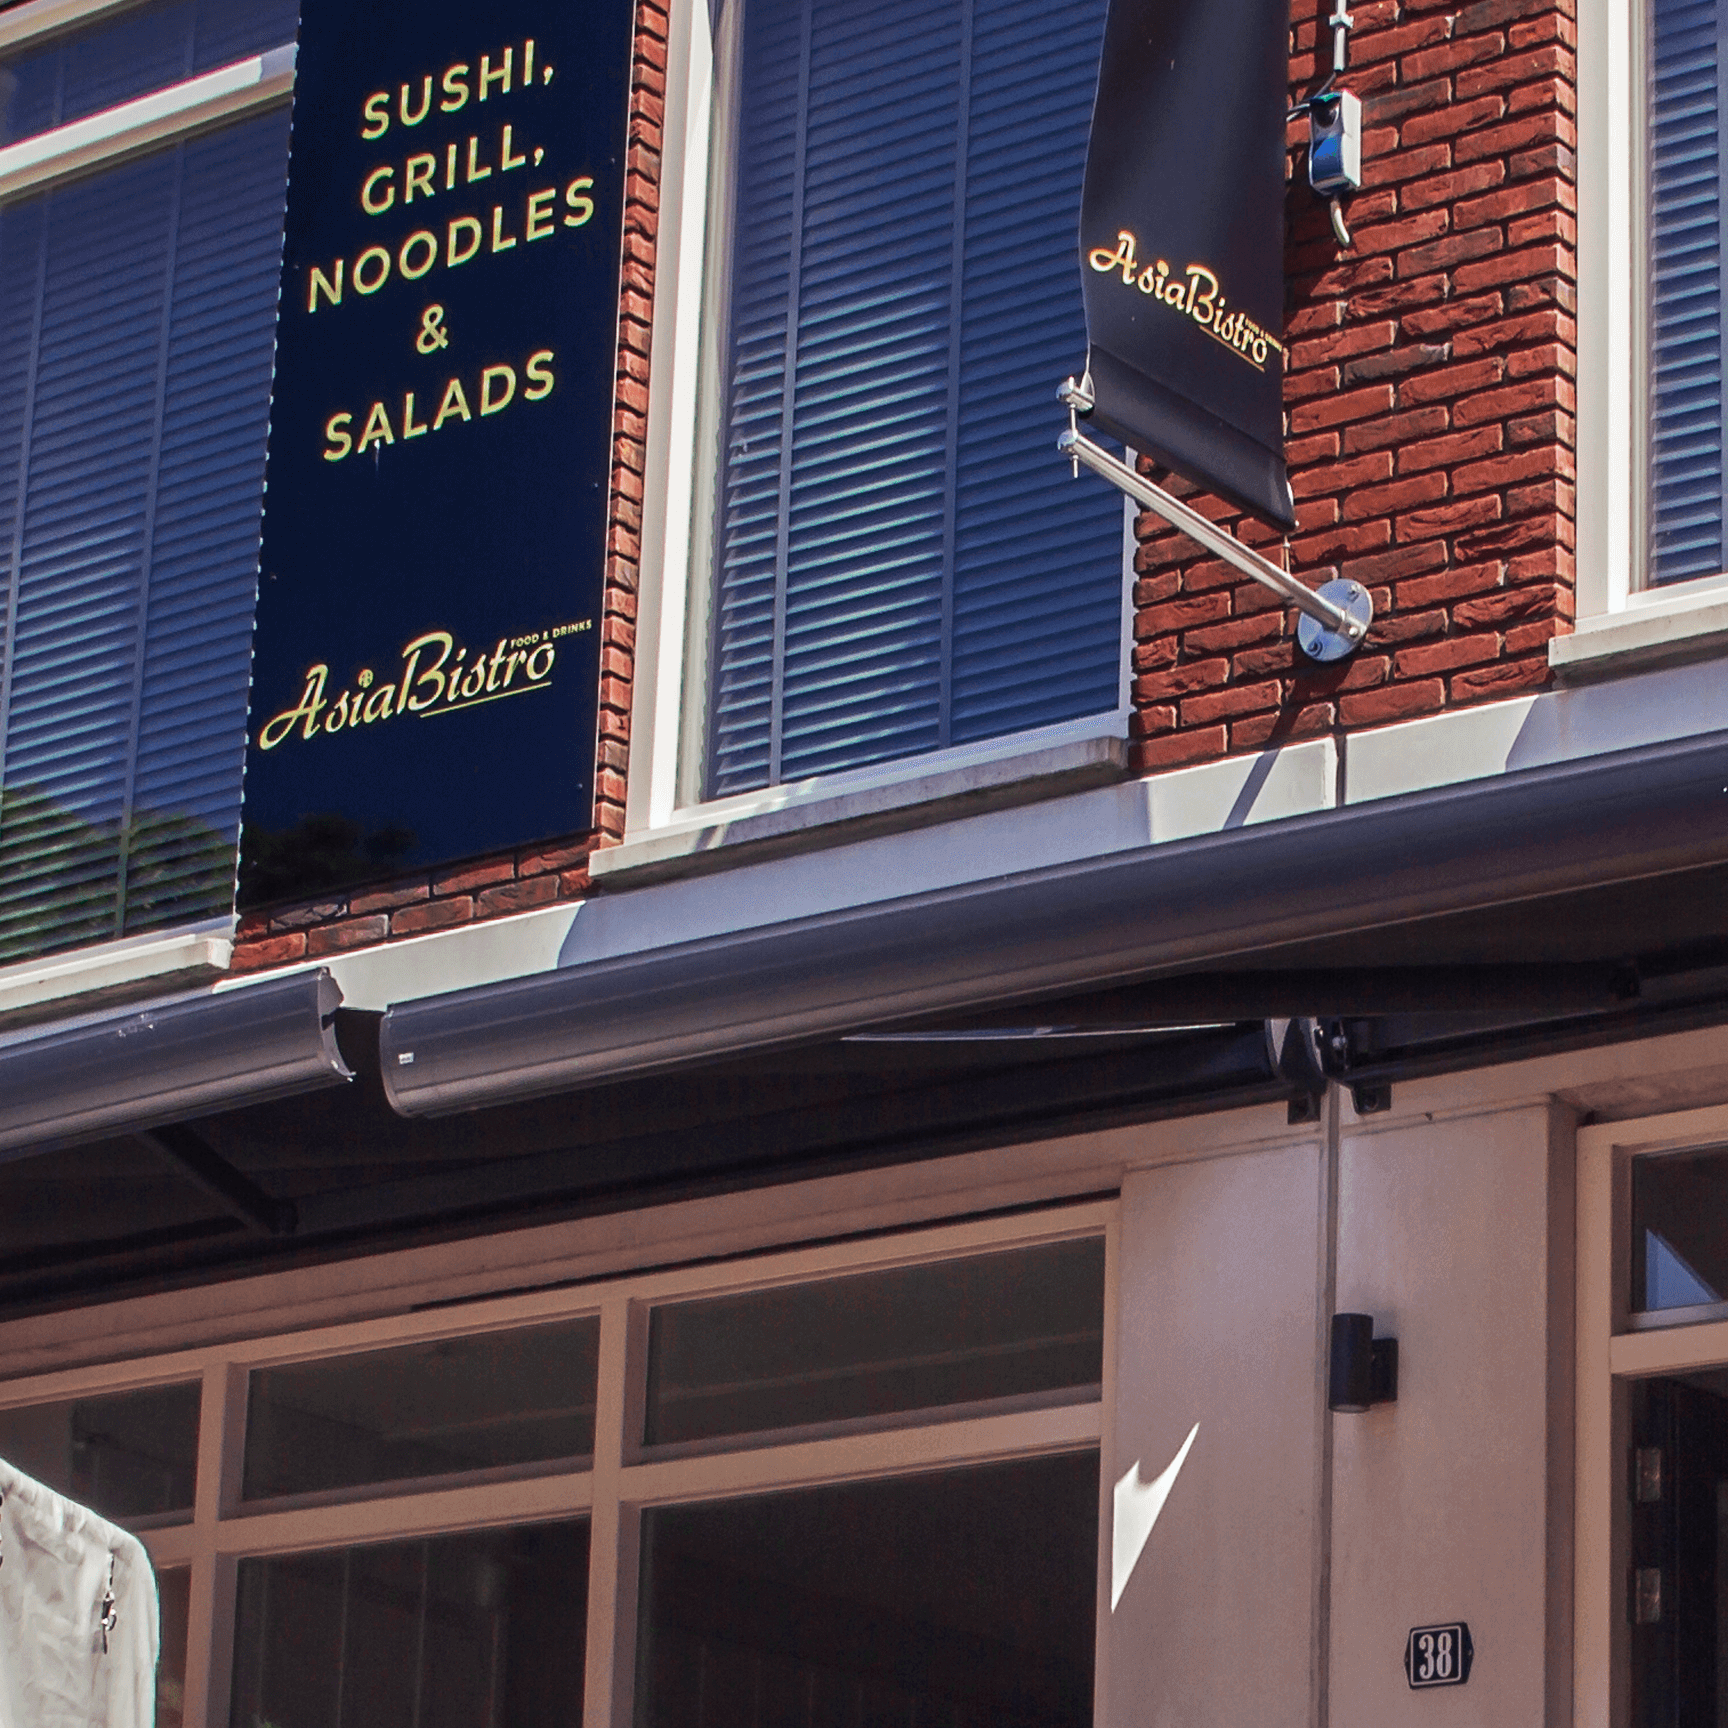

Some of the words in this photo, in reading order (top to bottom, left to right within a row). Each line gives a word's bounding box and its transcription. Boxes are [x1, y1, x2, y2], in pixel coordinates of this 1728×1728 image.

[361, 39, 555, 141] SUSHI,
[360, 124, 546, 218] GRILL,
[307, 175, 596, 315] NOODLES
[416, 303, 449, 355] &
[1088, 230, 1268, 364] AsiaBistro
[322, 350, 557, 464] SALADS
[552, 619, 592, 638] DRINKS
[258, 631, 557, 751] AsiaBistro
[1418, 1631, 1453, 1680] 38
